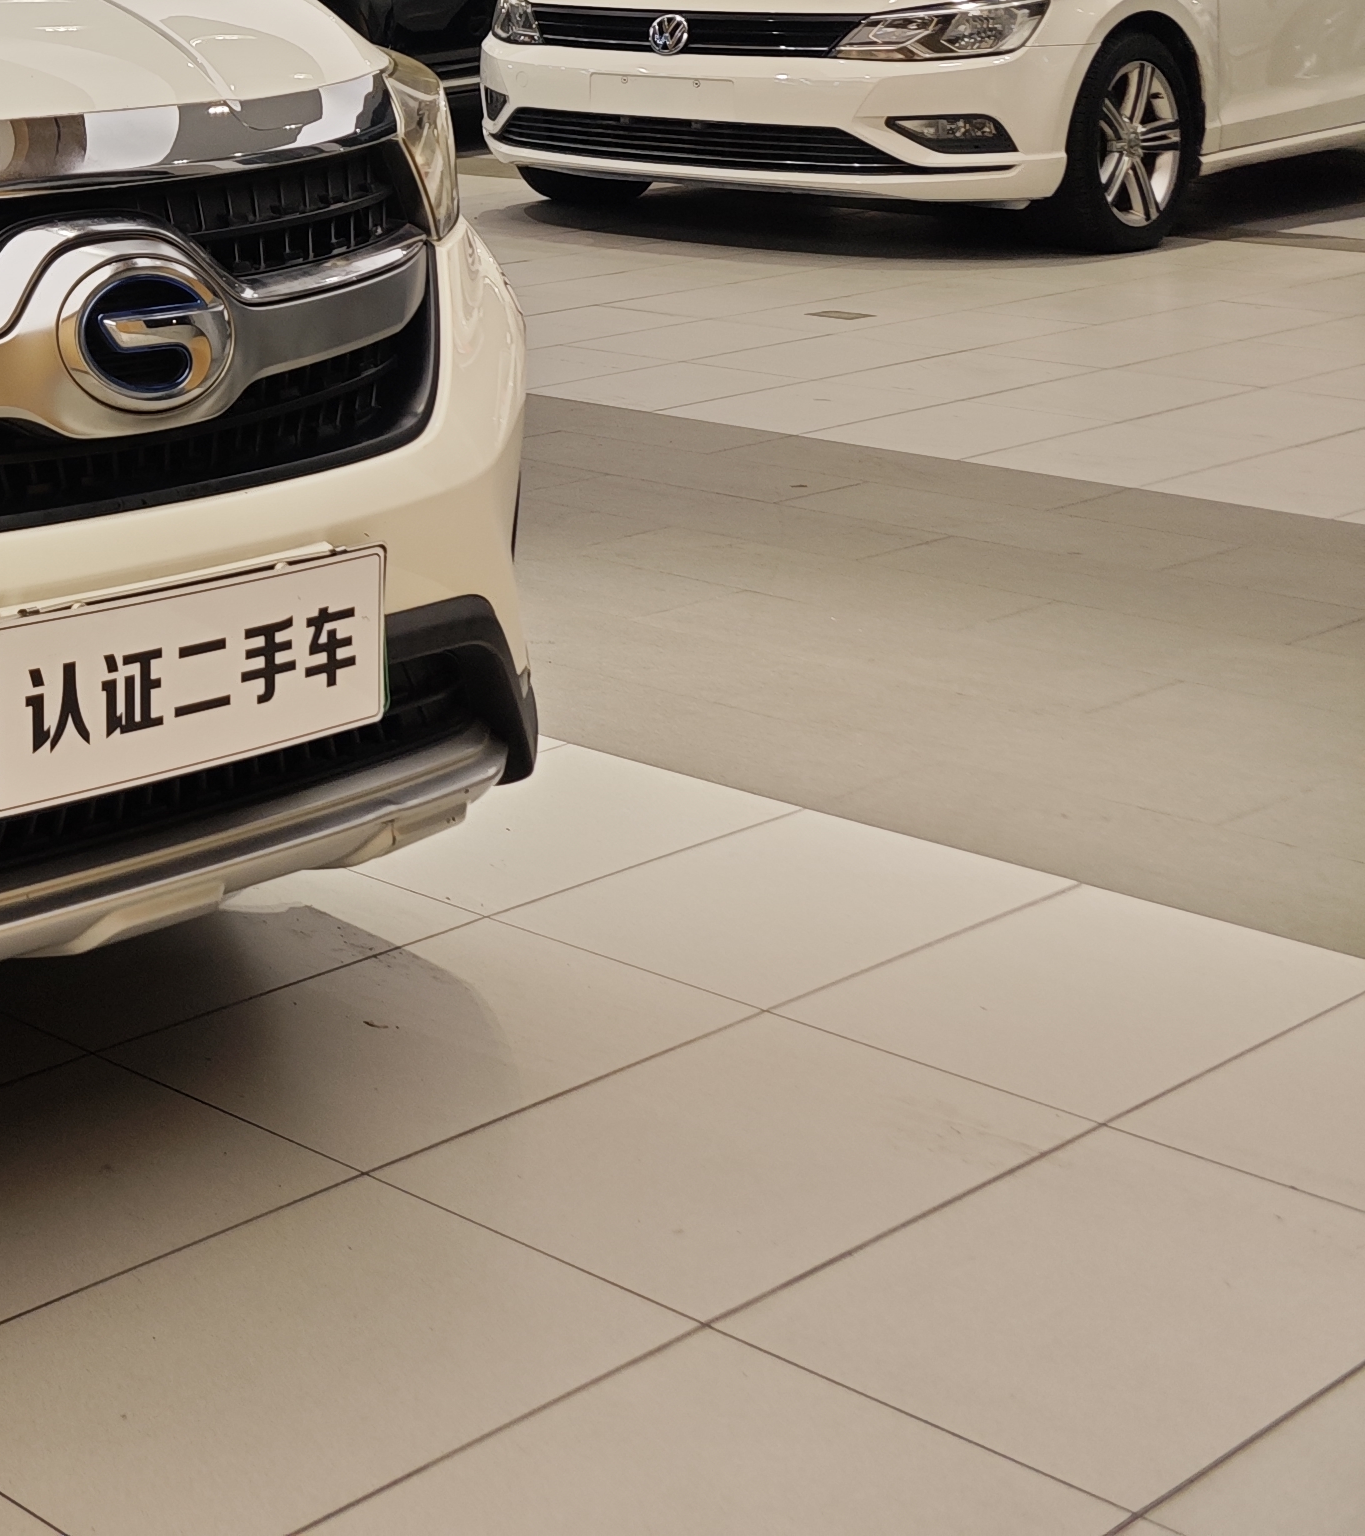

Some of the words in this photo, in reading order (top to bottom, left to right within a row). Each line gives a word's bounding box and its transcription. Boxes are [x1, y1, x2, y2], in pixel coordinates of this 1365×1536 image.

[24, 605, 357, 754] 认证二手车
